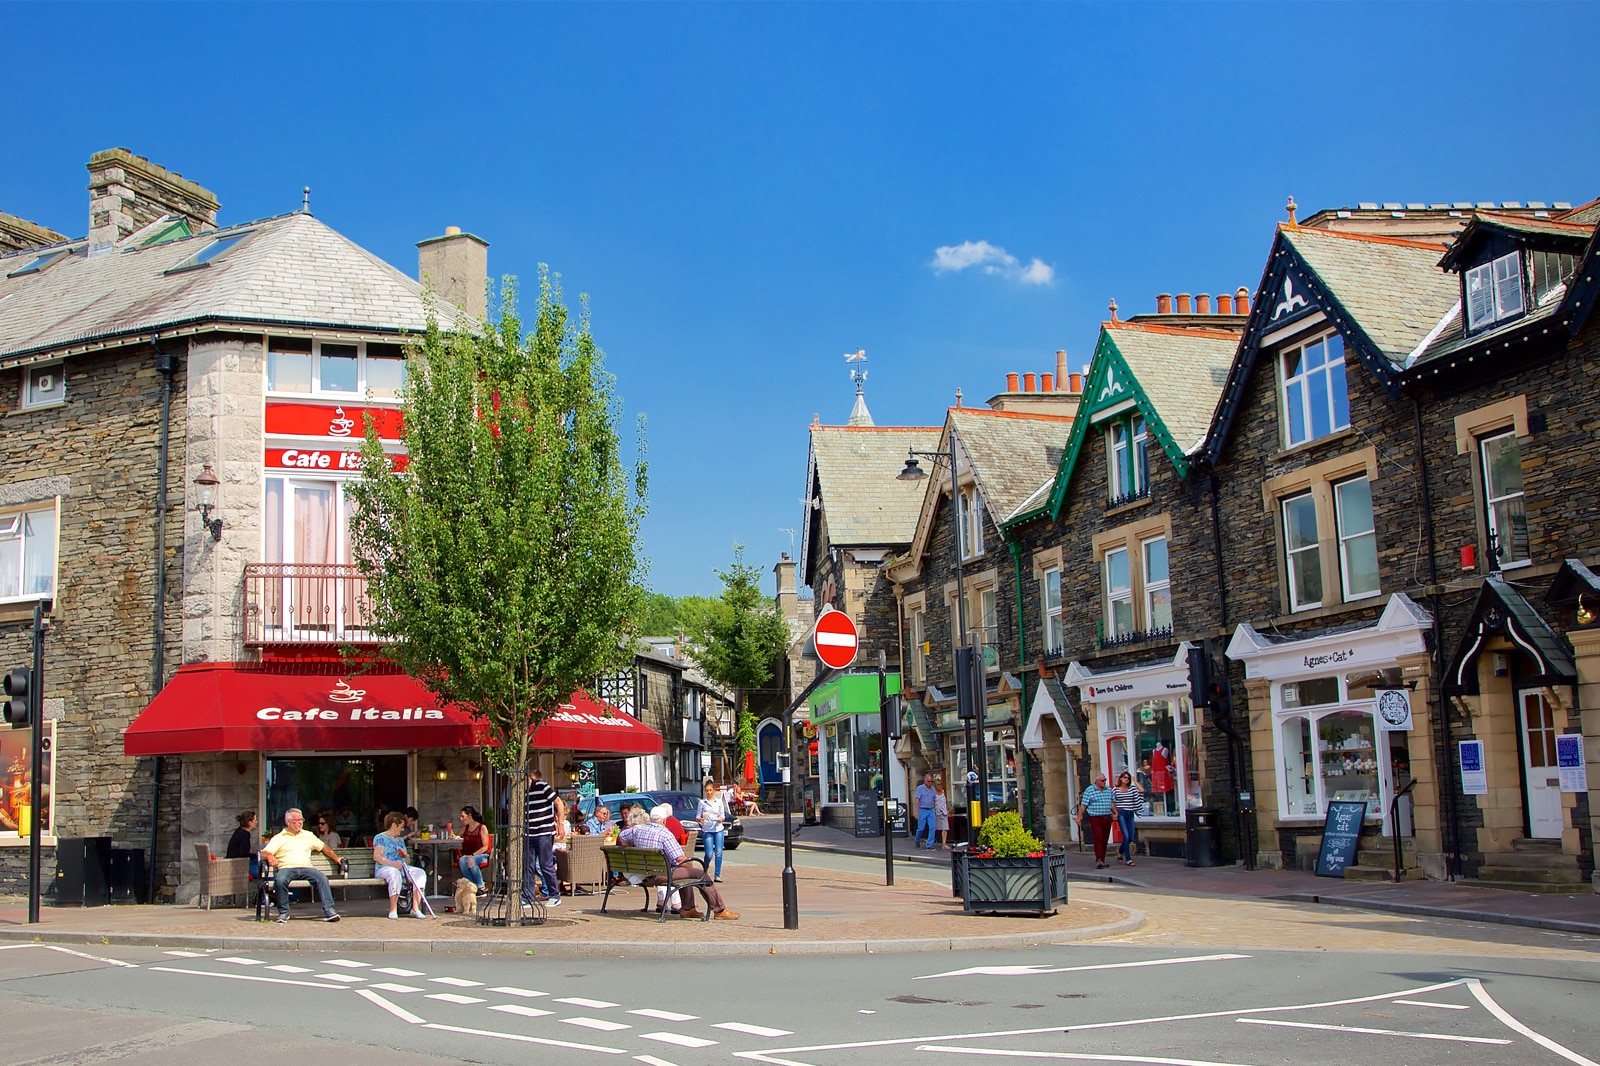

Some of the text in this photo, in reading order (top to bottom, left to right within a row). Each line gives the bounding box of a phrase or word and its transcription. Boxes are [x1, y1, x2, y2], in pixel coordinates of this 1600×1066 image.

[281, 450, 331, 468] Cafe
[1095, 687, 1106, 695] Save
[1114, 683, 1134, 692] Children
[256, 707, 445, 721] Cafe Italia
[581, 712, 634, 727] Italia
[1337, 823, 1350, 832] cat
